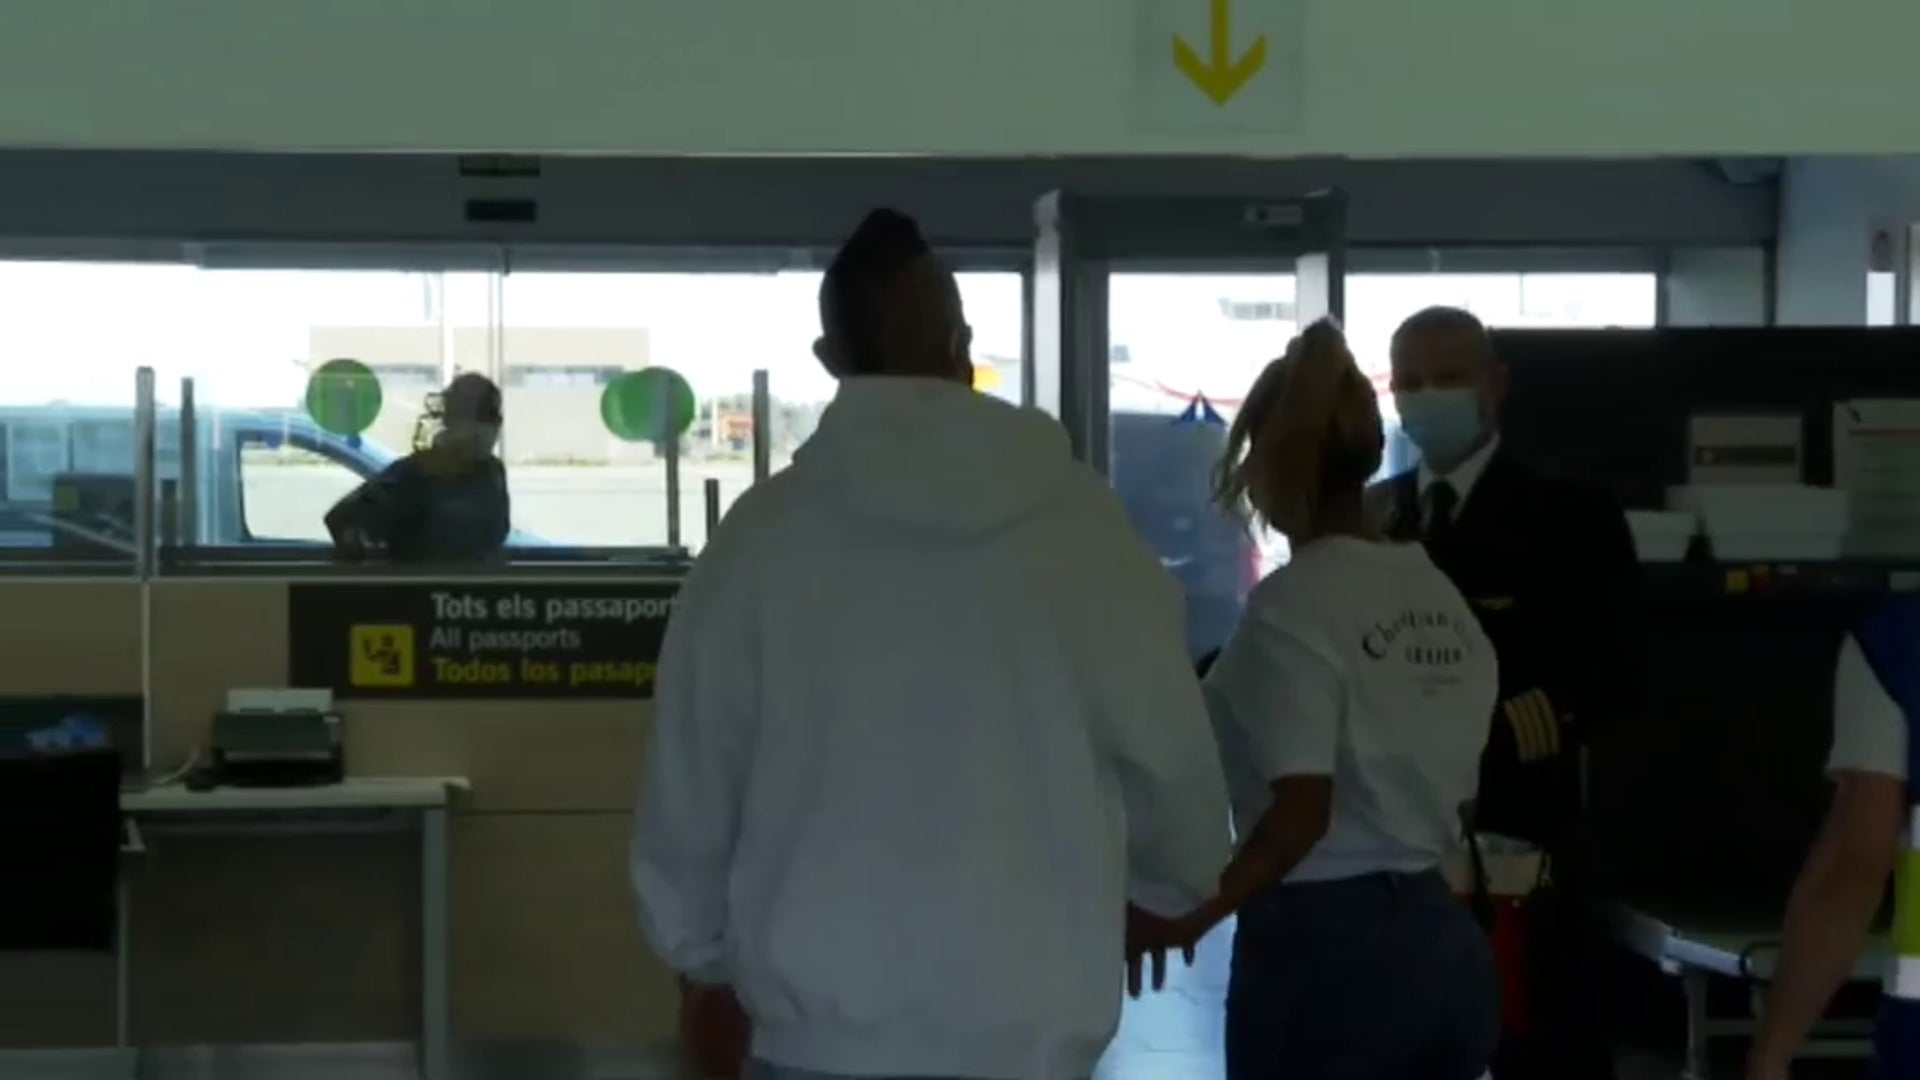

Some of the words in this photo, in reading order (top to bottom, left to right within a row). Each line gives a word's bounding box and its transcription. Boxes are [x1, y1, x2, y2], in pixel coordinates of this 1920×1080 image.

[430, 591, 487, 619] Tots
[496, 591, 536, 619] els
[430, 626, 463, 648] All
[470, 628, 580, 653] passports
[430, 656, 510, 683] Todos
[519, 656, 559, 683] los
[570, 659, 655, 688] pasap
